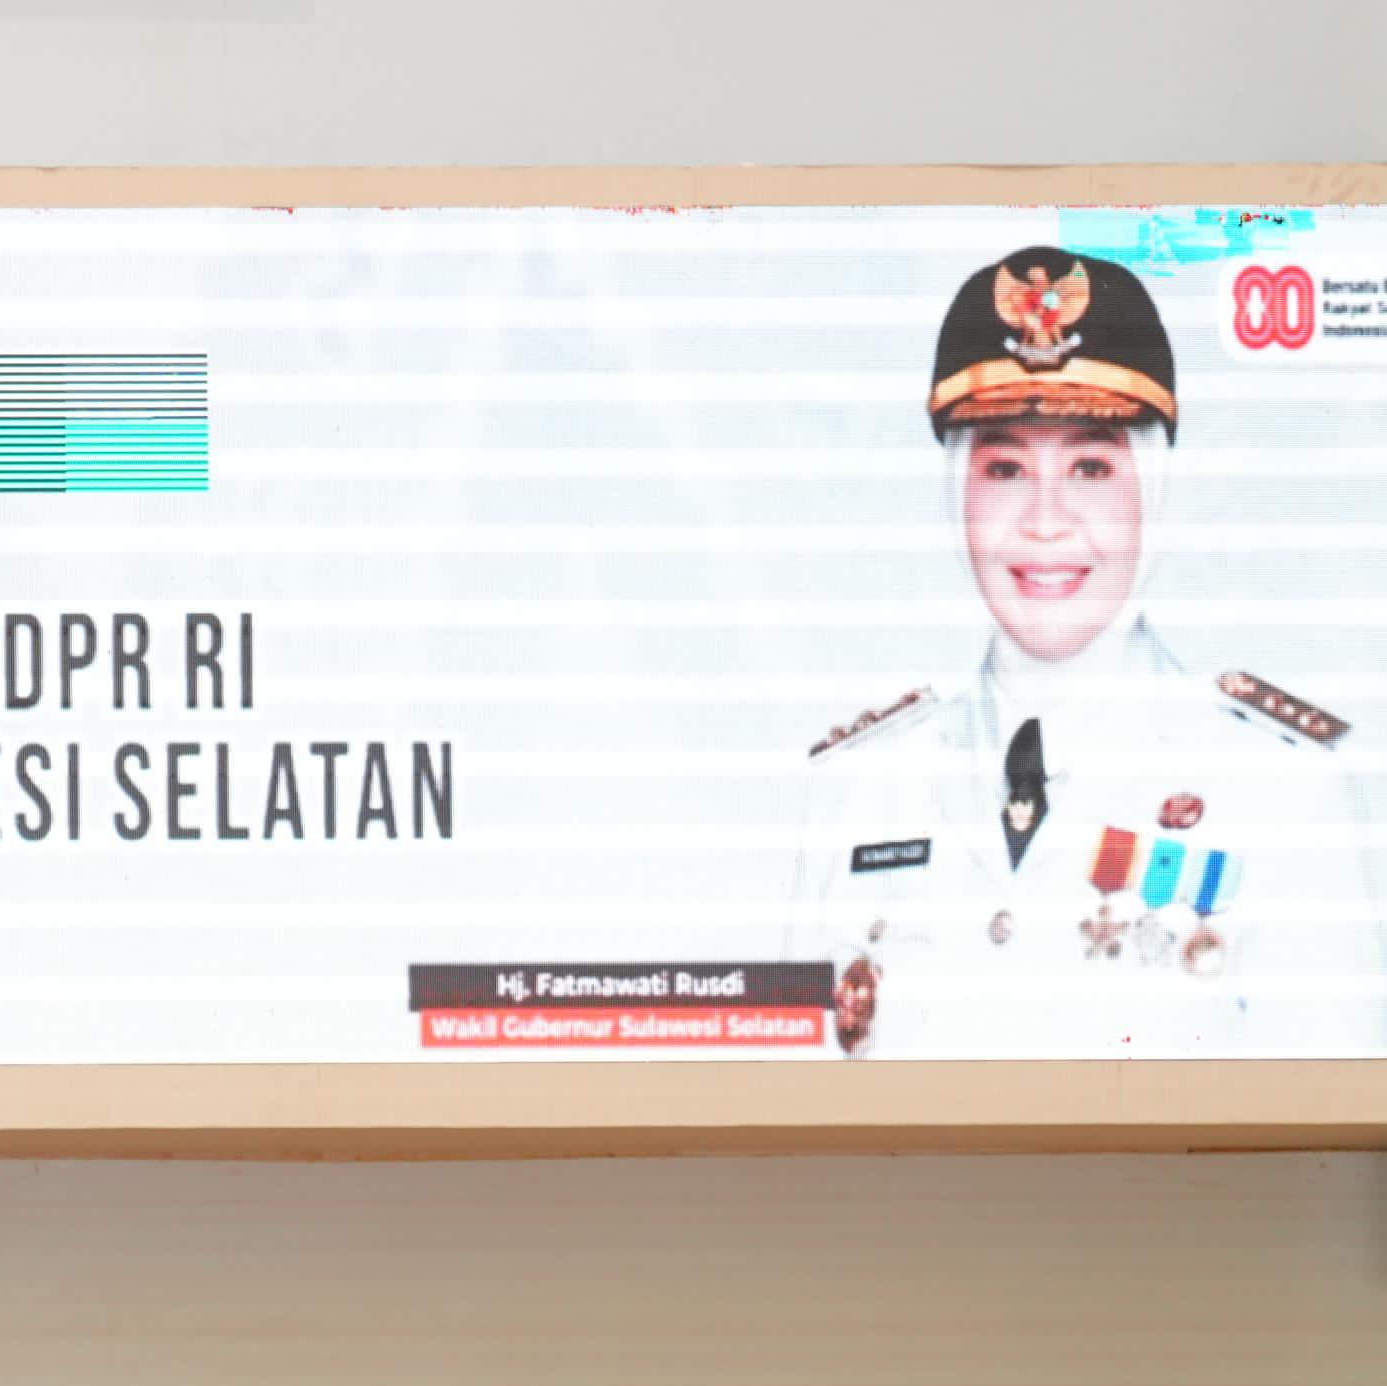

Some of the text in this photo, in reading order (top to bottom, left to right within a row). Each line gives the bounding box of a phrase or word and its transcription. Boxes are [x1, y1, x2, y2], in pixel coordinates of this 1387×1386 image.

[4, 612, 151, 710] DPR
[185, 611, 253, 709] RI
[113, 741, 455, 842] SELATAN
[497, 971, 745, 1000] Hj. Fatmawati Rusdi
[431, 1013, 814, 1041] Wakil Gubernur Sulawesi Selatan
